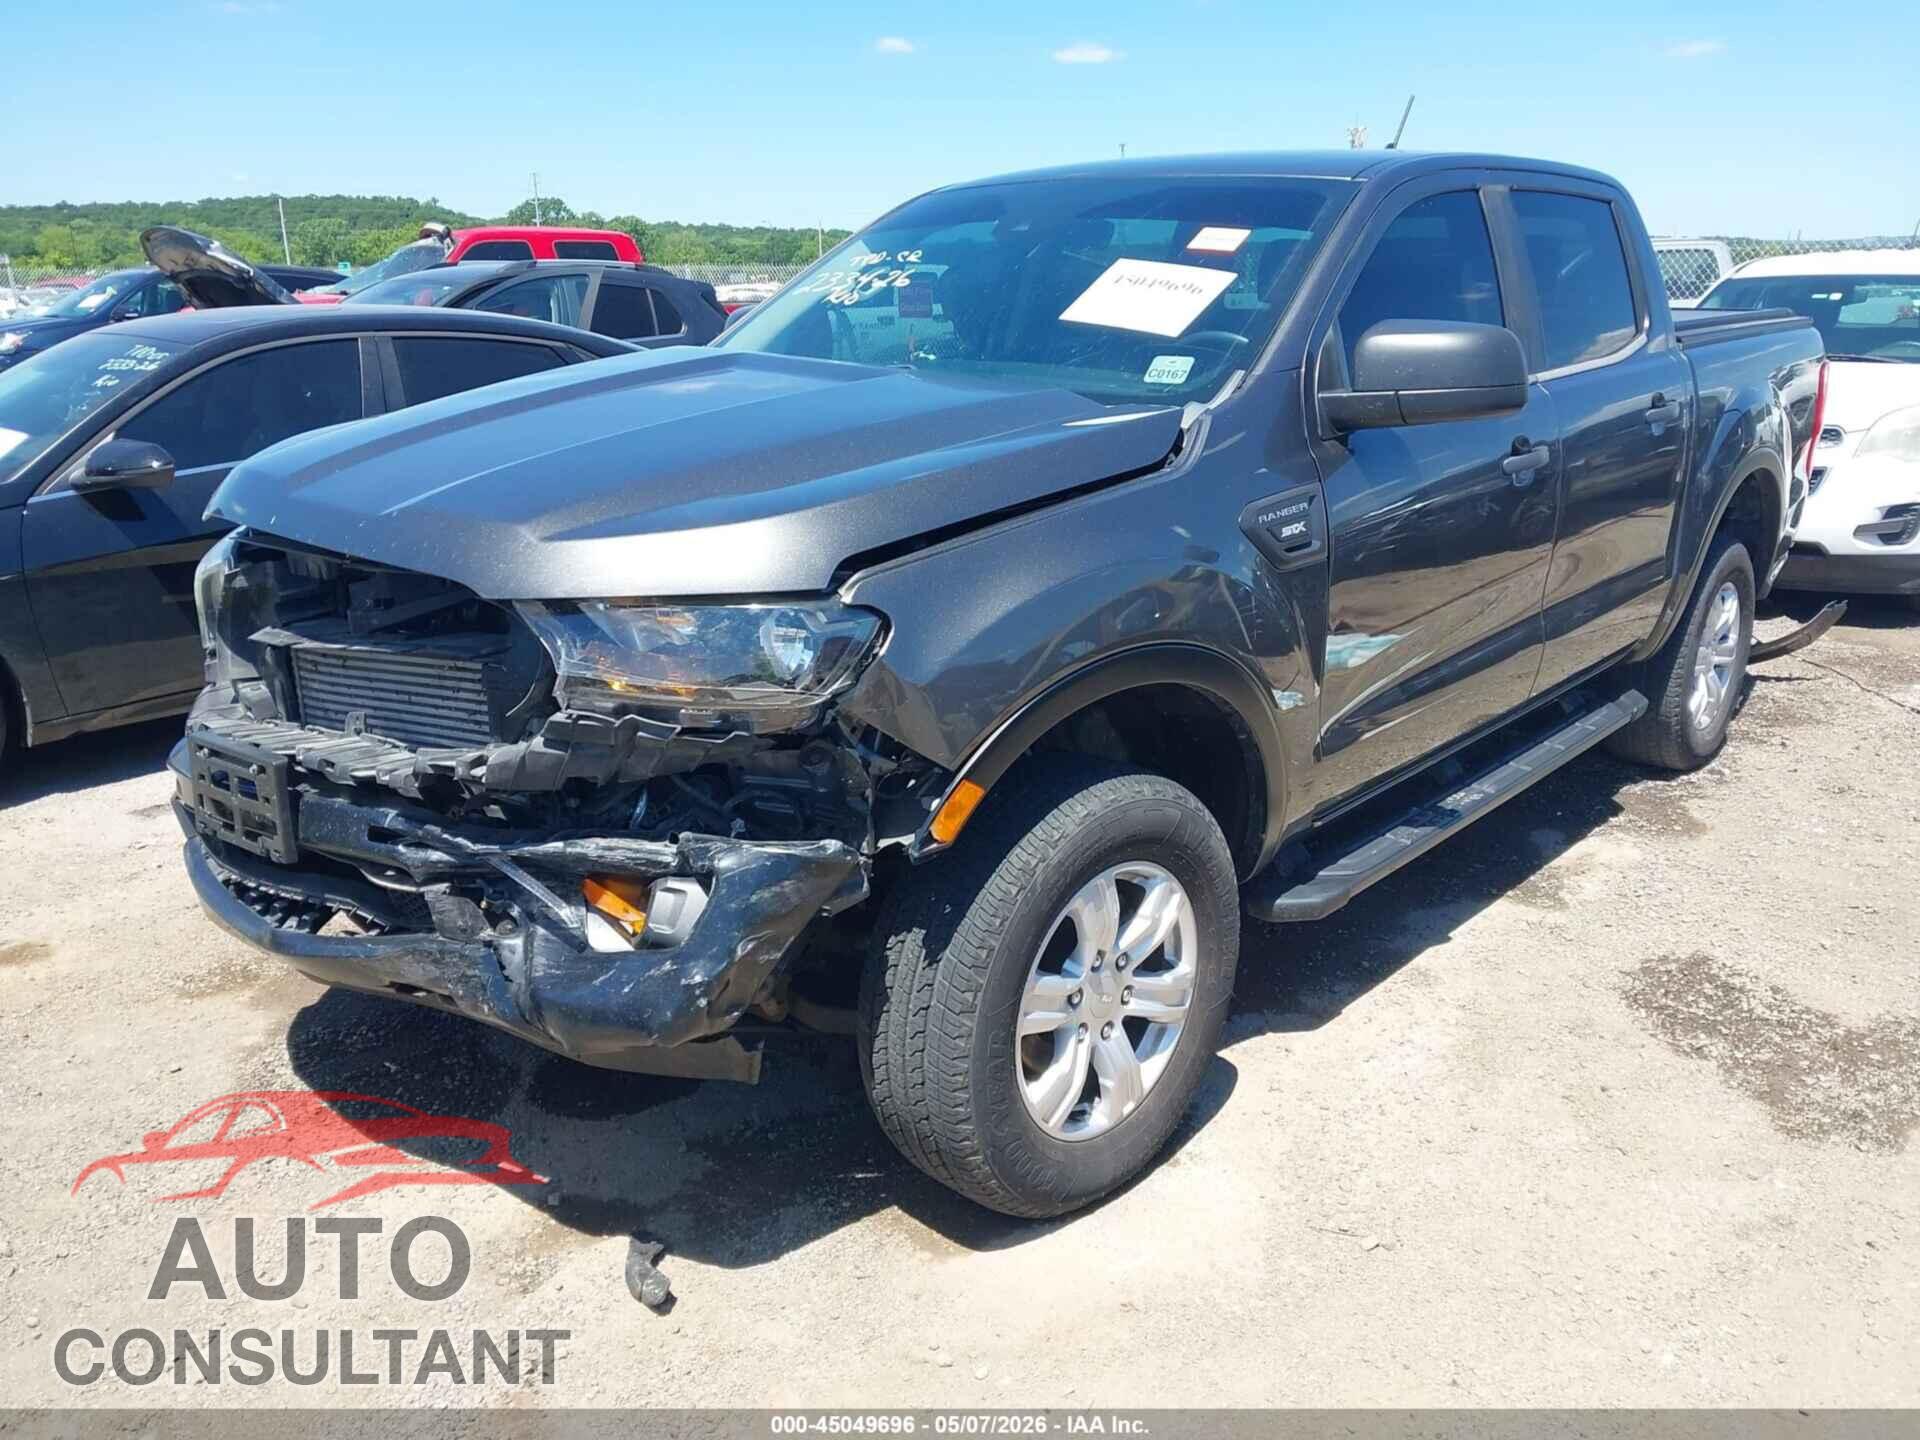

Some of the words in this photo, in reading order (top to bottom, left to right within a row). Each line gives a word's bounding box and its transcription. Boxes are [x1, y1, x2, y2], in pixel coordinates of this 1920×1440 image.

[1147, 368, 1188, 380] C0167
[1258, 502, 1309, 524] RANGER
[1281, 521, 1307, 538] STX
